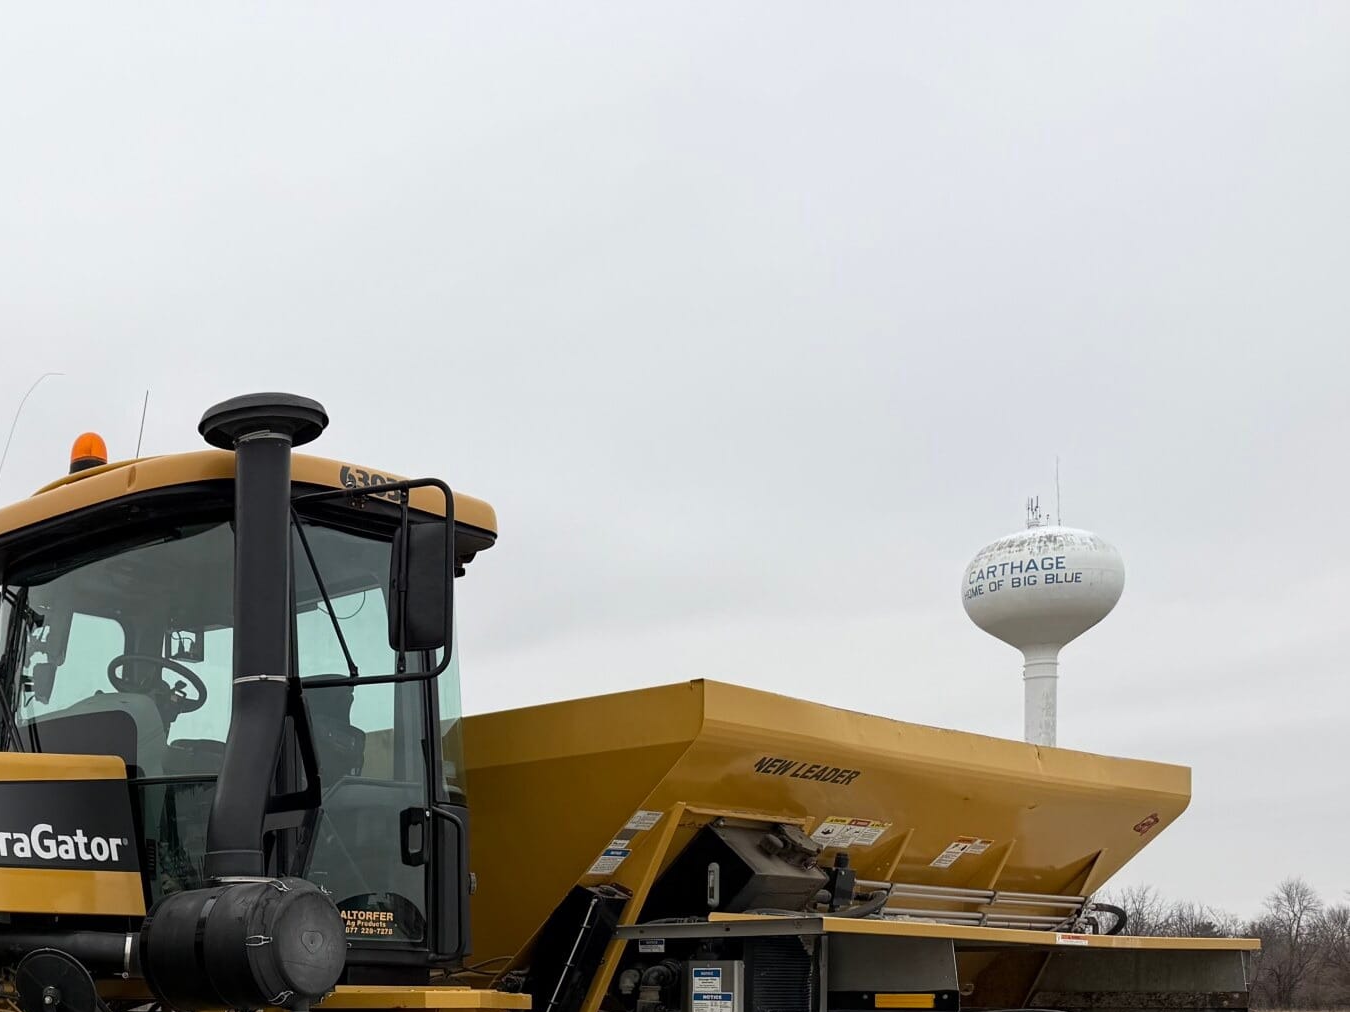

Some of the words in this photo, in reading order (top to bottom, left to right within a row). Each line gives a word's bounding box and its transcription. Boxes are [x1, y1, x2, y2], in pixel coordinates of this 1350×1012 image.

[969, 556, 1066, 585] CARTHAGE
[963, 584, 984, 600] HOME
[989, 580, 1003, 592] OF
[1011, 575, 1037, 588] BIG
[1045, 572, 1082, 585] BLUE
[754, 757, 798, 776] NEW
[790, 763, 861, 785] LEADER
[340, 910, 394, 921] ALTORFER
